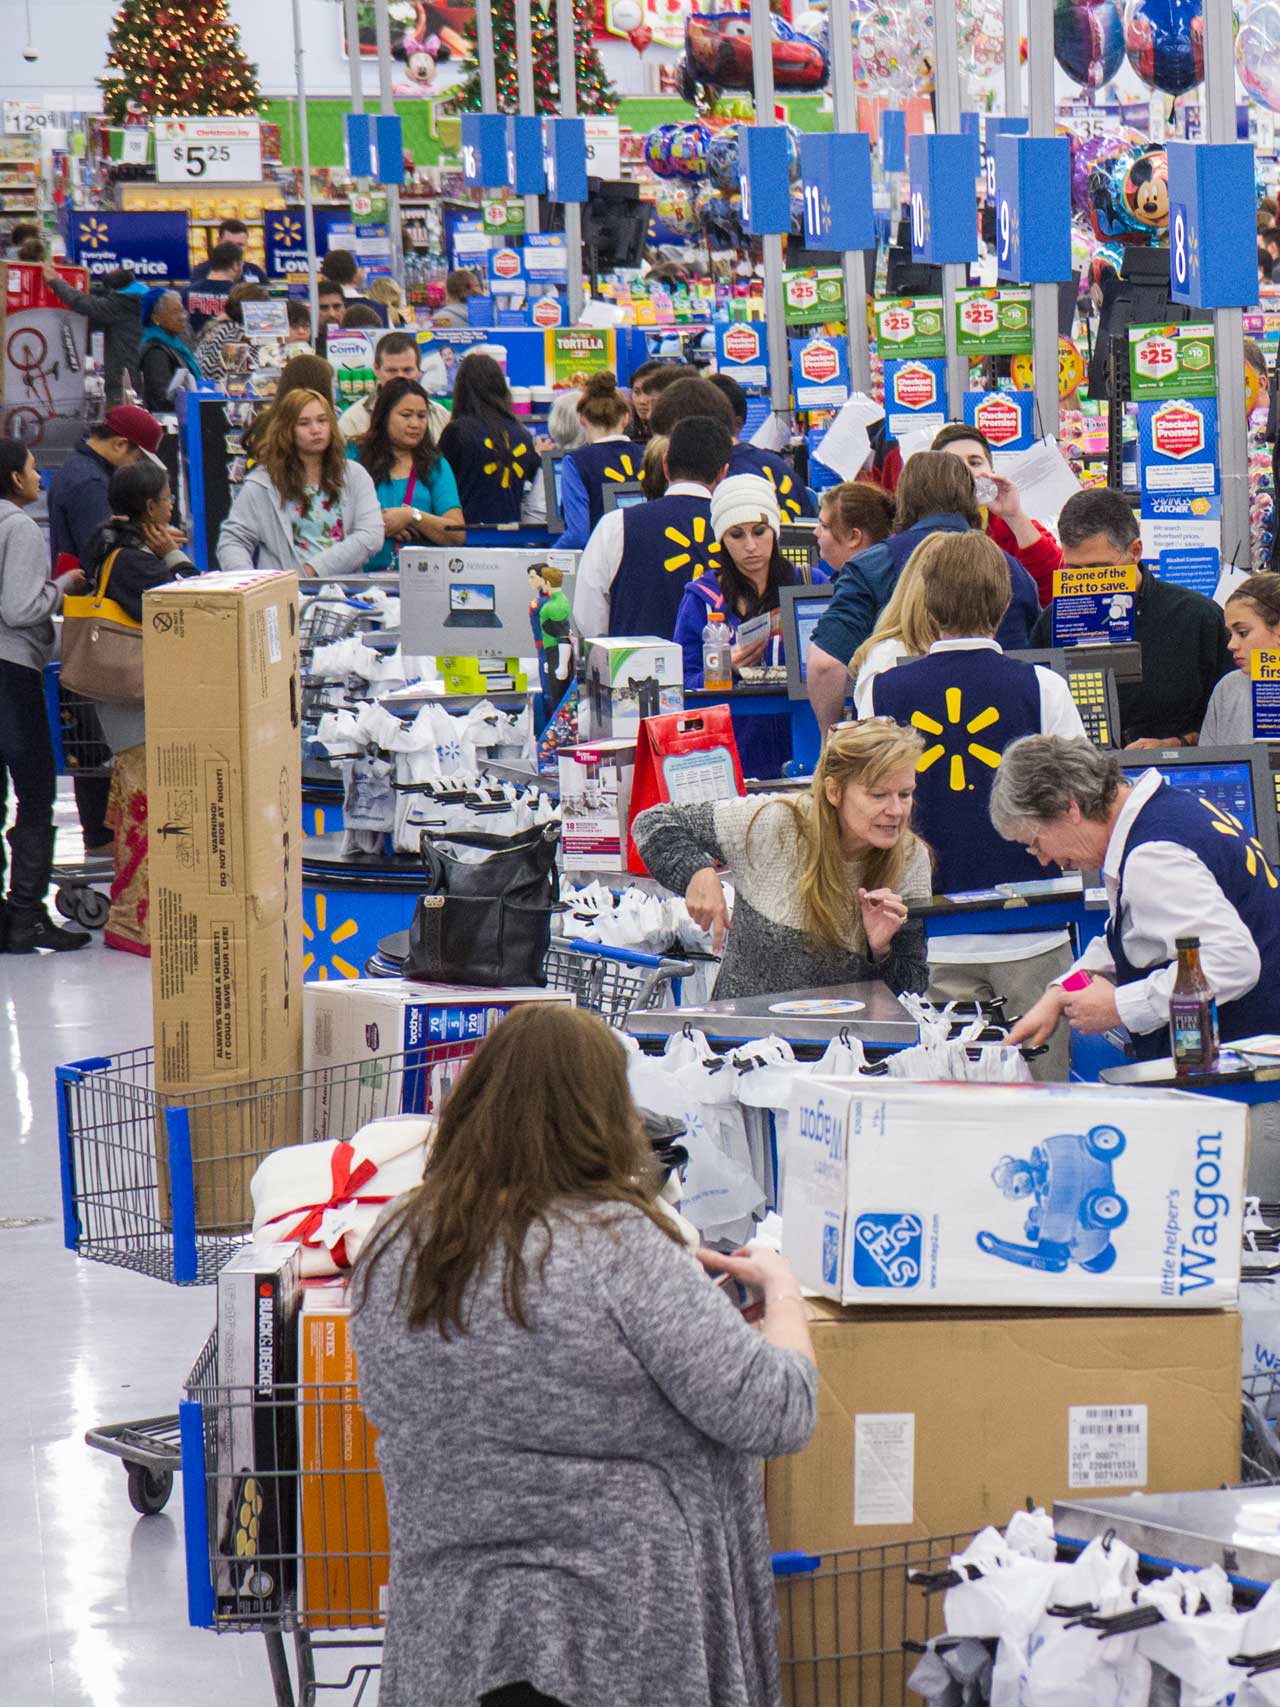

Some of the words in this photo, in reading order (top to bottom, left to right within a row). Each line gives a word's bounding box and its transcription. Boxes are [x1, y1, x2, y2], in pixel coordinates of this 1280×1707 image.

[806, 186, 821, 236] 11
[912, 192, 924, 248] 10
[1000, 200, 1010, 262] 9
[1175, 214, 1186, 284] 8
[122, 258, 168, 275] Price
[965, 309, 994, 323] $25
[884, 317, 910, 331] $25
[1140, 348, 1173, 365] $25
[898, 378, 931, 386] Checkout
[898, 385, 931, 393] Promise
[978, 412, 1016, 420] Checkout
[980, 420, 1016, 428] Promise
[1157, 420, 1199, 430] Checkout
[1158, 429, 1198, 438] Promise
[448, 559, 464, 574] hp
[1060, 572, 1074, 582] Be
[1075, 571, 1093, 580] one
[1095, 570, 1106, 579] of
[1107, 569, 1127, 578] the
[1060, 583, 1088, 595] first
[1089, 583, 1099, 593] to
[1100, 582, 1129, 592] save.
[706, 653, 718, 668] G
[1260, 652, 1276, 664] Be
[219, 848, 227, 869] NOT
[220, 872, 227, 887] DO
[408, 1008, 419, 1045] brother
[430, 1018, 439, 1033] 70
[452, 1020, 460, 1028] 5
[468, 1014, 478, 1033] 120
[1179, 1130, 1230, 1297] Wagon
[1163, 1188, 1182, 1257] helper's
[890, 1214, 922, 1247] 2
[856, 1220, 919, 1287] STEP
[1162, 1257, 1175, 1297] little
[258, 1298, 274, 1395] BLACK&DECKER
